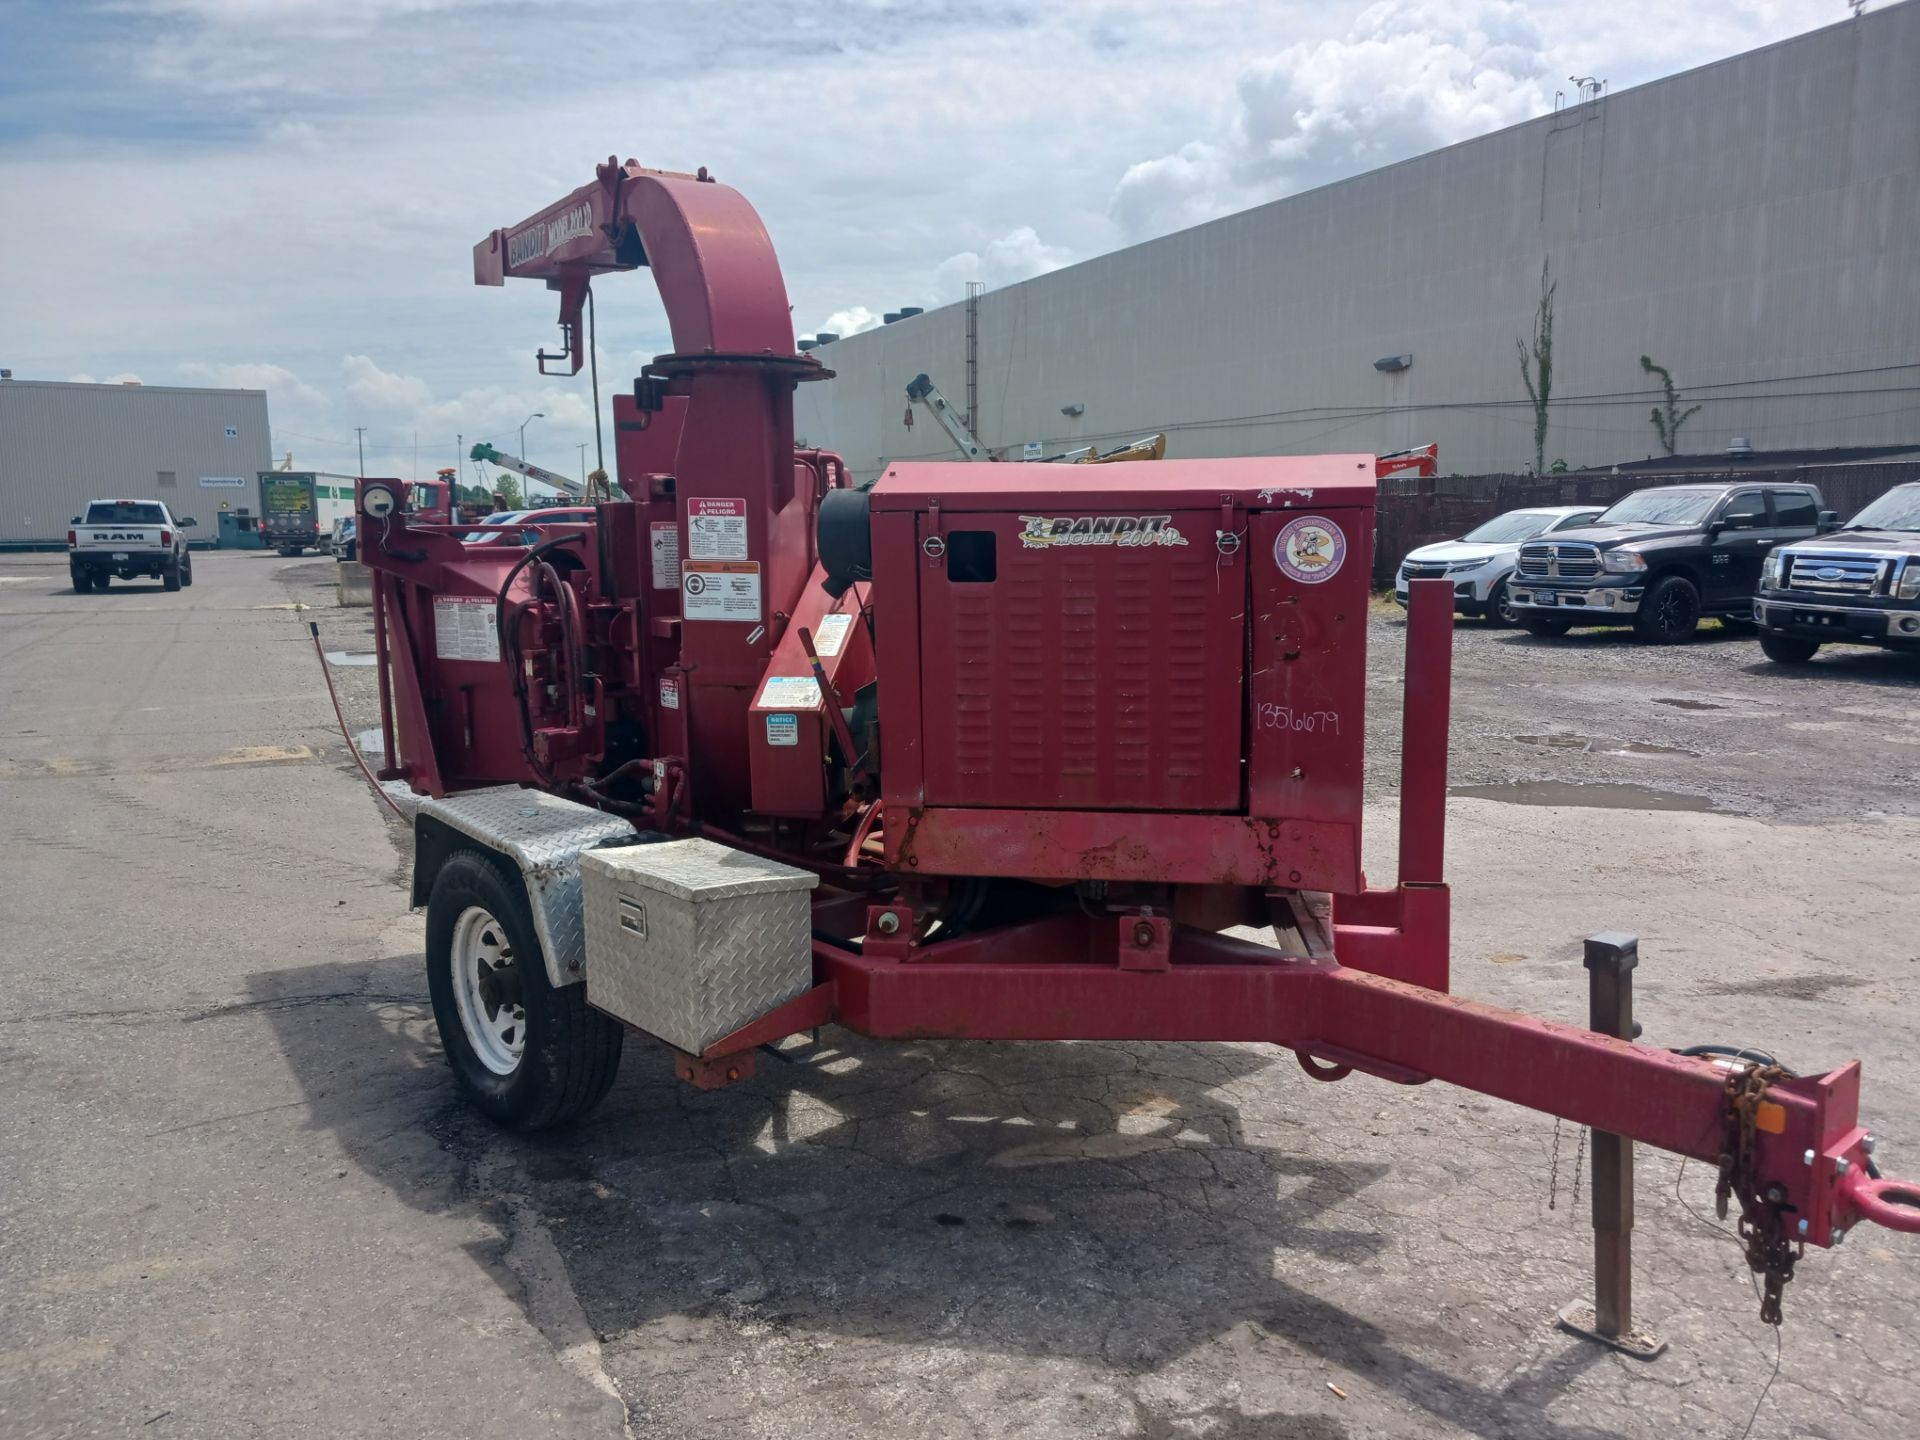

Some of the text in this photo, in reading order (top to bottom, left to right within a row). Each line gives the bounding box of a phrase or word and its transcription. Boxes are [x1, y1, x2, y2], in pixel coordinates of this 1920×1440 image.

[508, 223, 545, 268] BANDIT
[1049, 515, 1171, 535] BANDIT
[93, 533, 144, 541] RAM
[1054, 533, 1113, 546] MODEL
[1117, 530, 1155, 547] 200
[1256, 702, 1340, 735] 1356679
